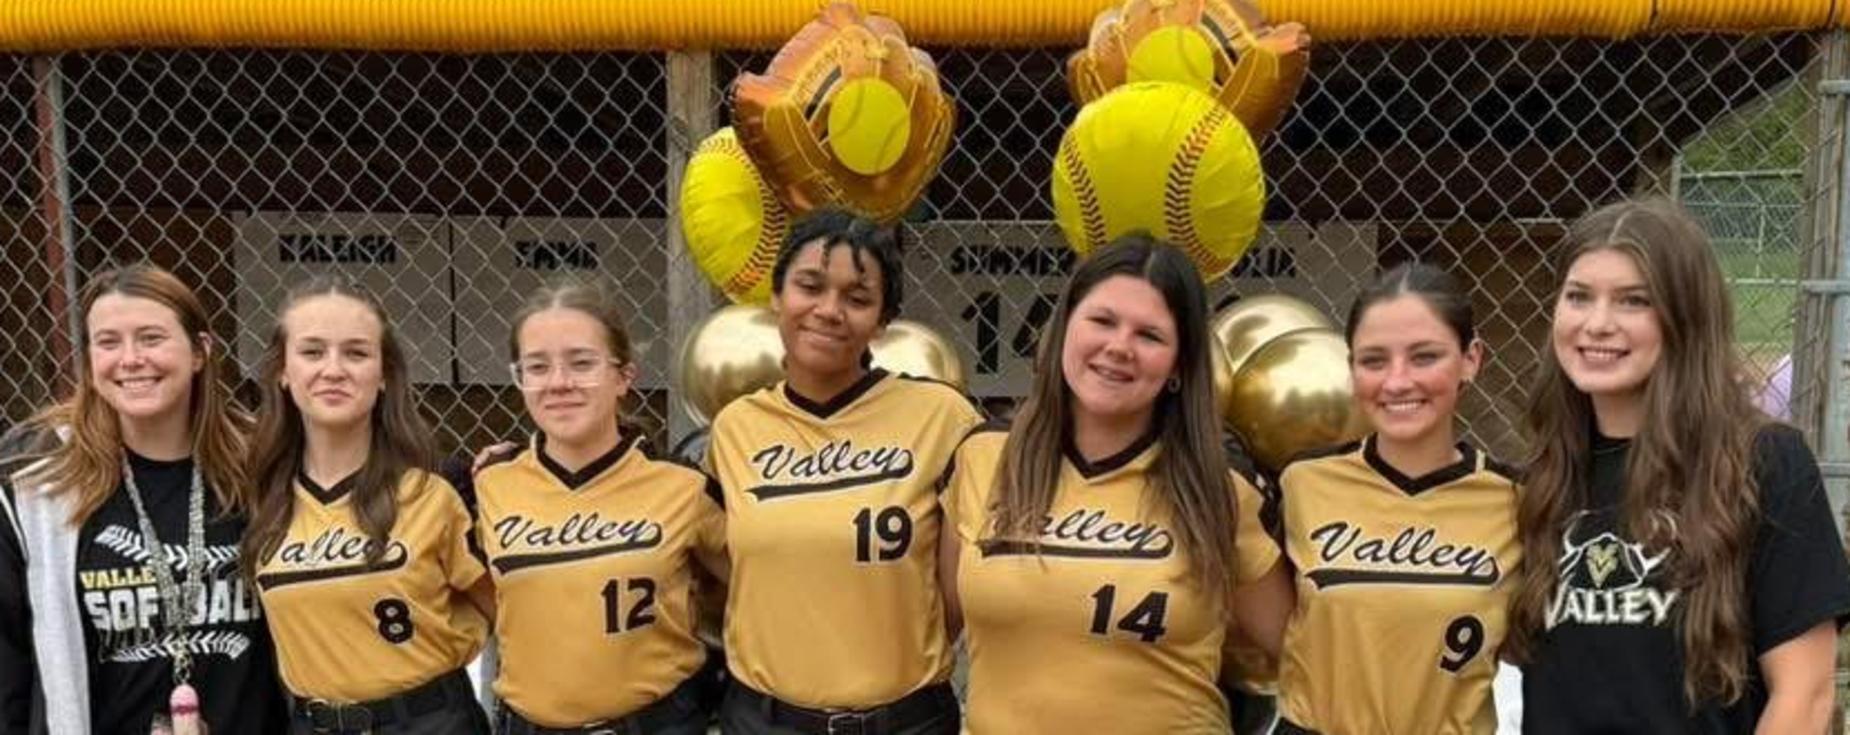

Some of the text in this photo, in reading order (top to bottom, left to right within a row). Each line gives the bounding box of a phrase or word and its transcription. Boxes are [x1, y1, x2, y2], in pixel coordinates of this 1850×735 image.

[752, 440, 914, 482] Valley
[494, 513, 662, 553] Valley
[852, 505, 913, 563] 19
[990, 508, 1174, 557] lley
[1310, 521, 1499, 583] Valley
[80, 567, 156, 589] VALLE
[84, 578, 261, 631] SOFAL
[600, 576, 657, 634] 12
[1544, 576, 1681, 631] VALLEY
[373, 598, 414, 645] 8
[1090, 583, 1169, 643] 14
[1440, 615, 1485, 672] 9
